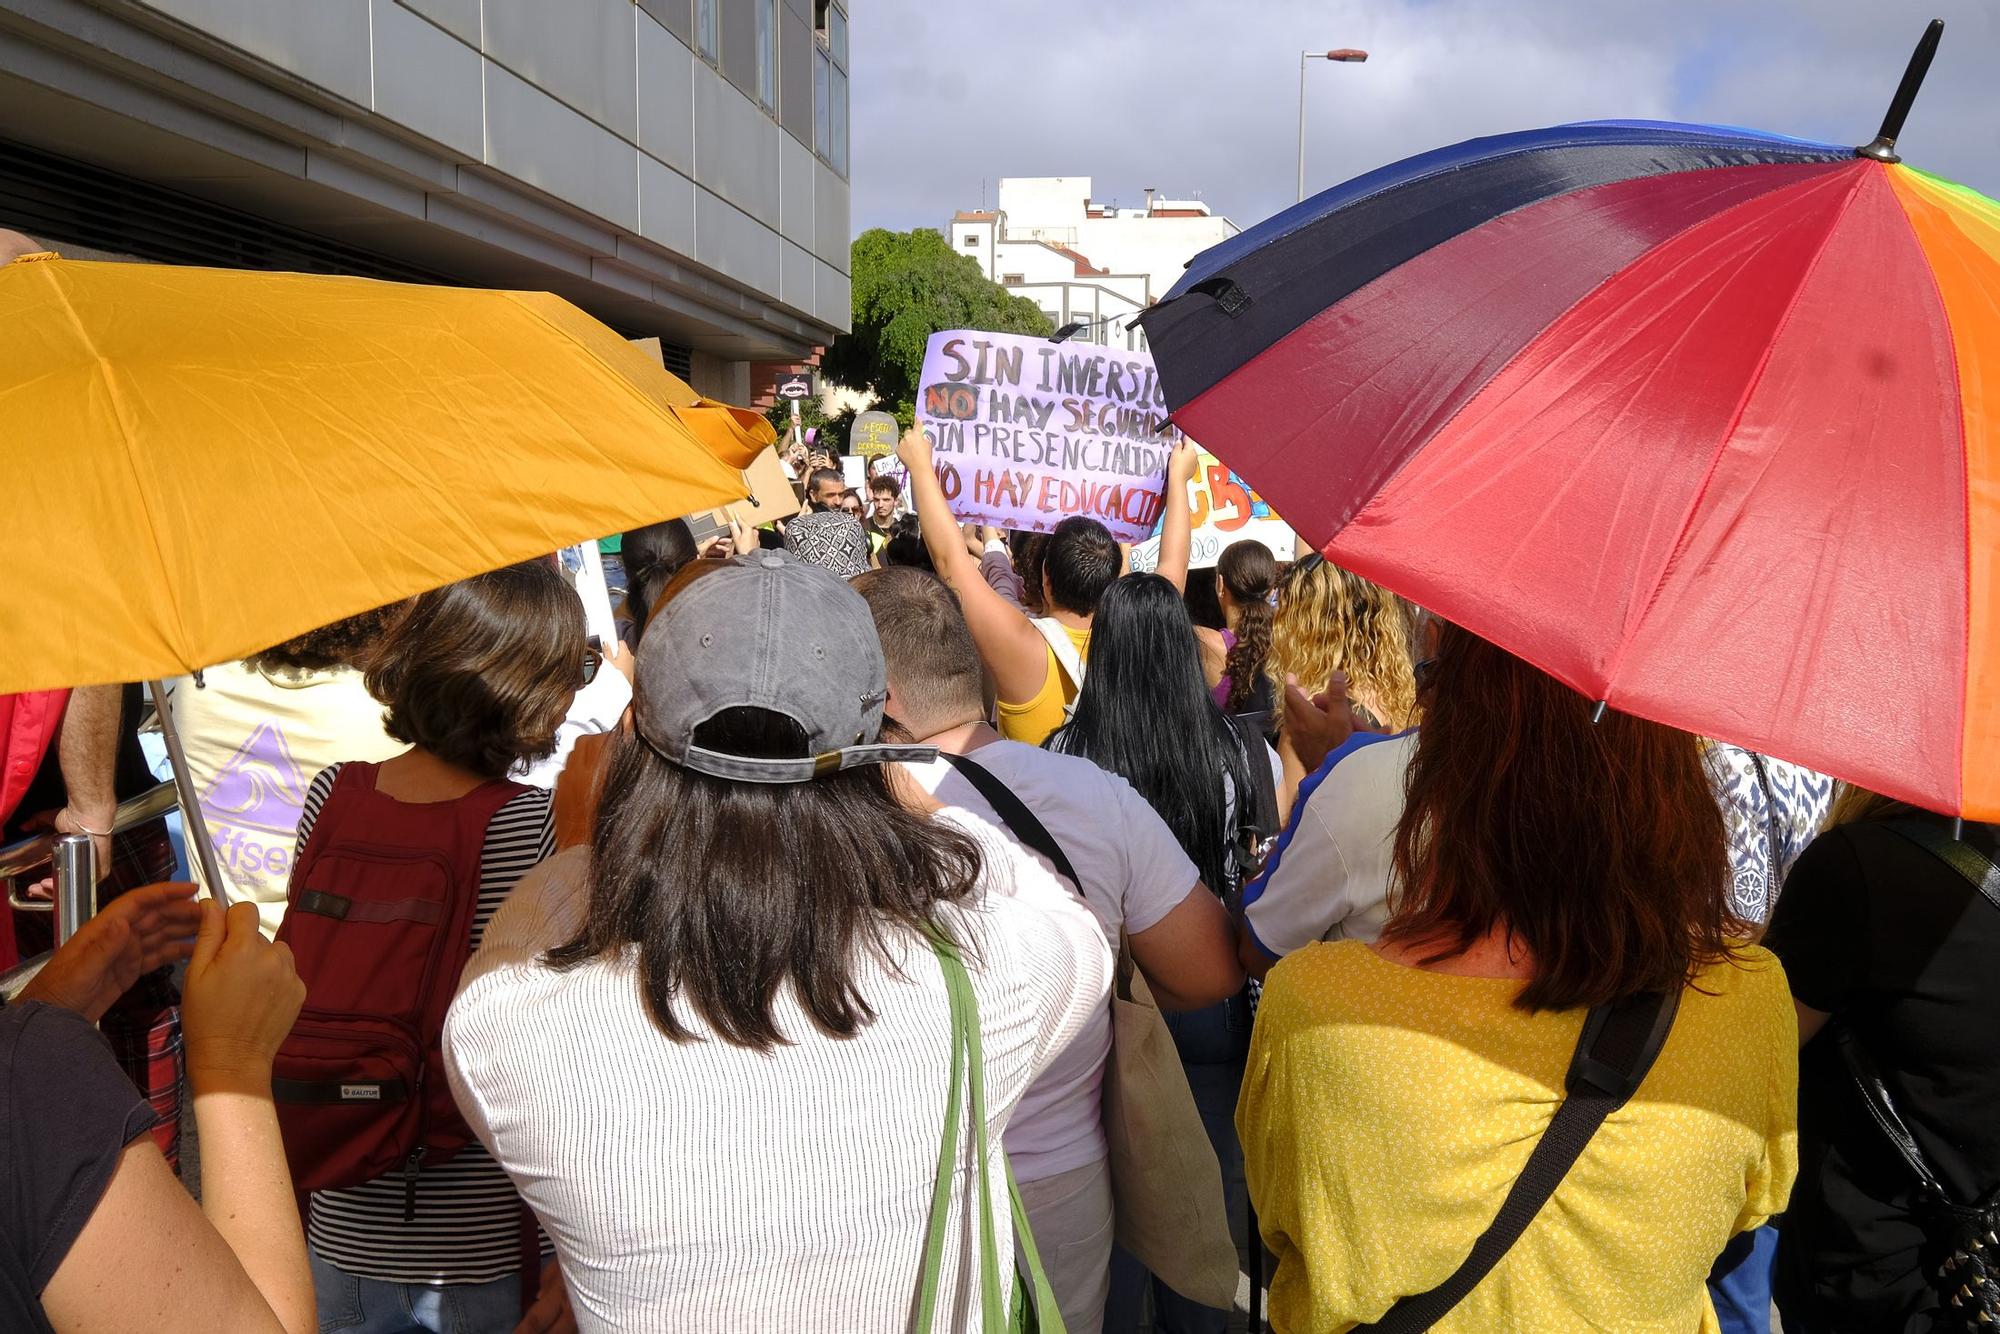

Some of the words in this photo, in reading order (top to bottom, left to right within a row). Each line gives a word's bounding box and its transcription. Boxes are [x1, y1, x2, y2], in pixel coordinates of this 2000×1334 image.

[942, 339, 1024, 386] SIN
[925, 384, 977, 418] NO
[989, 389, 1056, 431] HAY
[922, 420, 964, 454] SIN
[974, 468, 1034, 508] HAY
